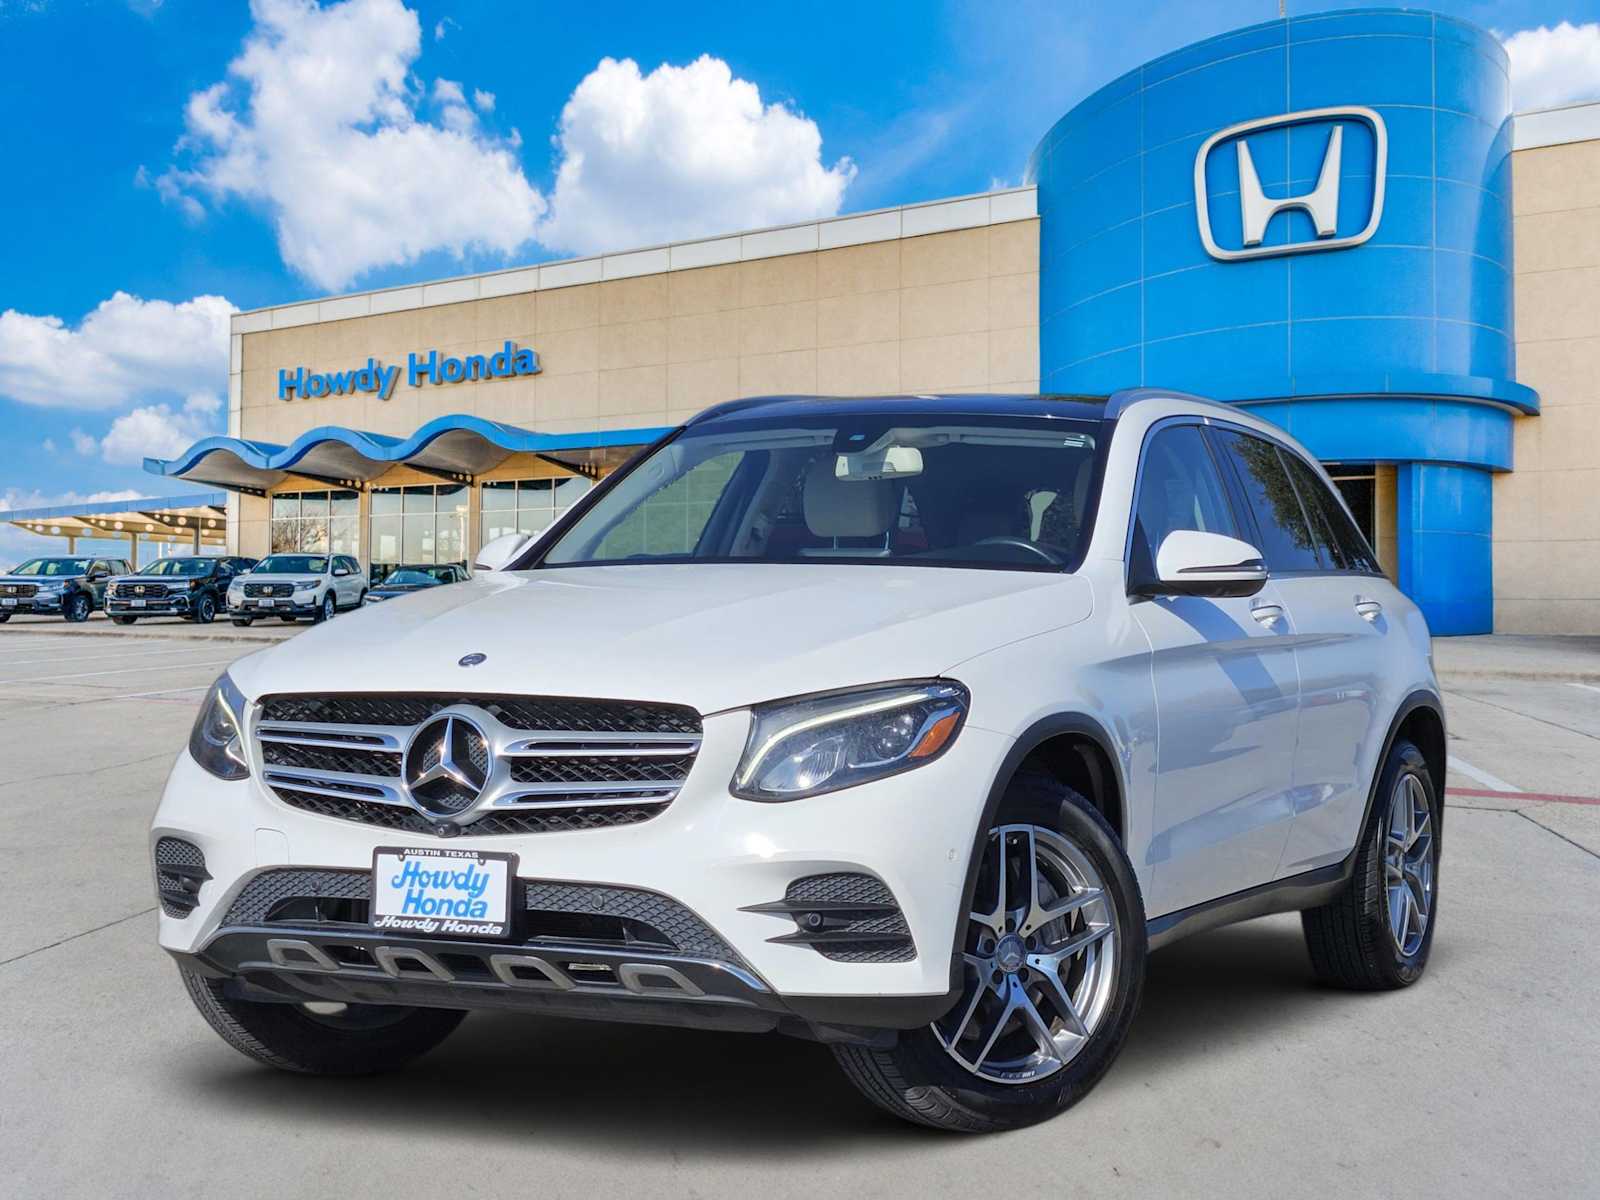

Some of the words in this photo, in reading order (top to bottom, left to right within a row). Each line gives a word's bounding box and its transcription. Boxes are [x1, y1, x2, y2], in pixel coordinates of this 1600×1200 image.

[278, 357, 401, 401] Howdy
[408, 340, 542, 388] Honda
[403, 848, 441, 857] AUSTIN
[444, 850, 479, 859] TEXAS
[391, 861, 490, 898] Howdy
[401, 889, 488, 918] Honda
[374, 916, 439, 933] Howdy
[441, 920, 503, 935] Honda
